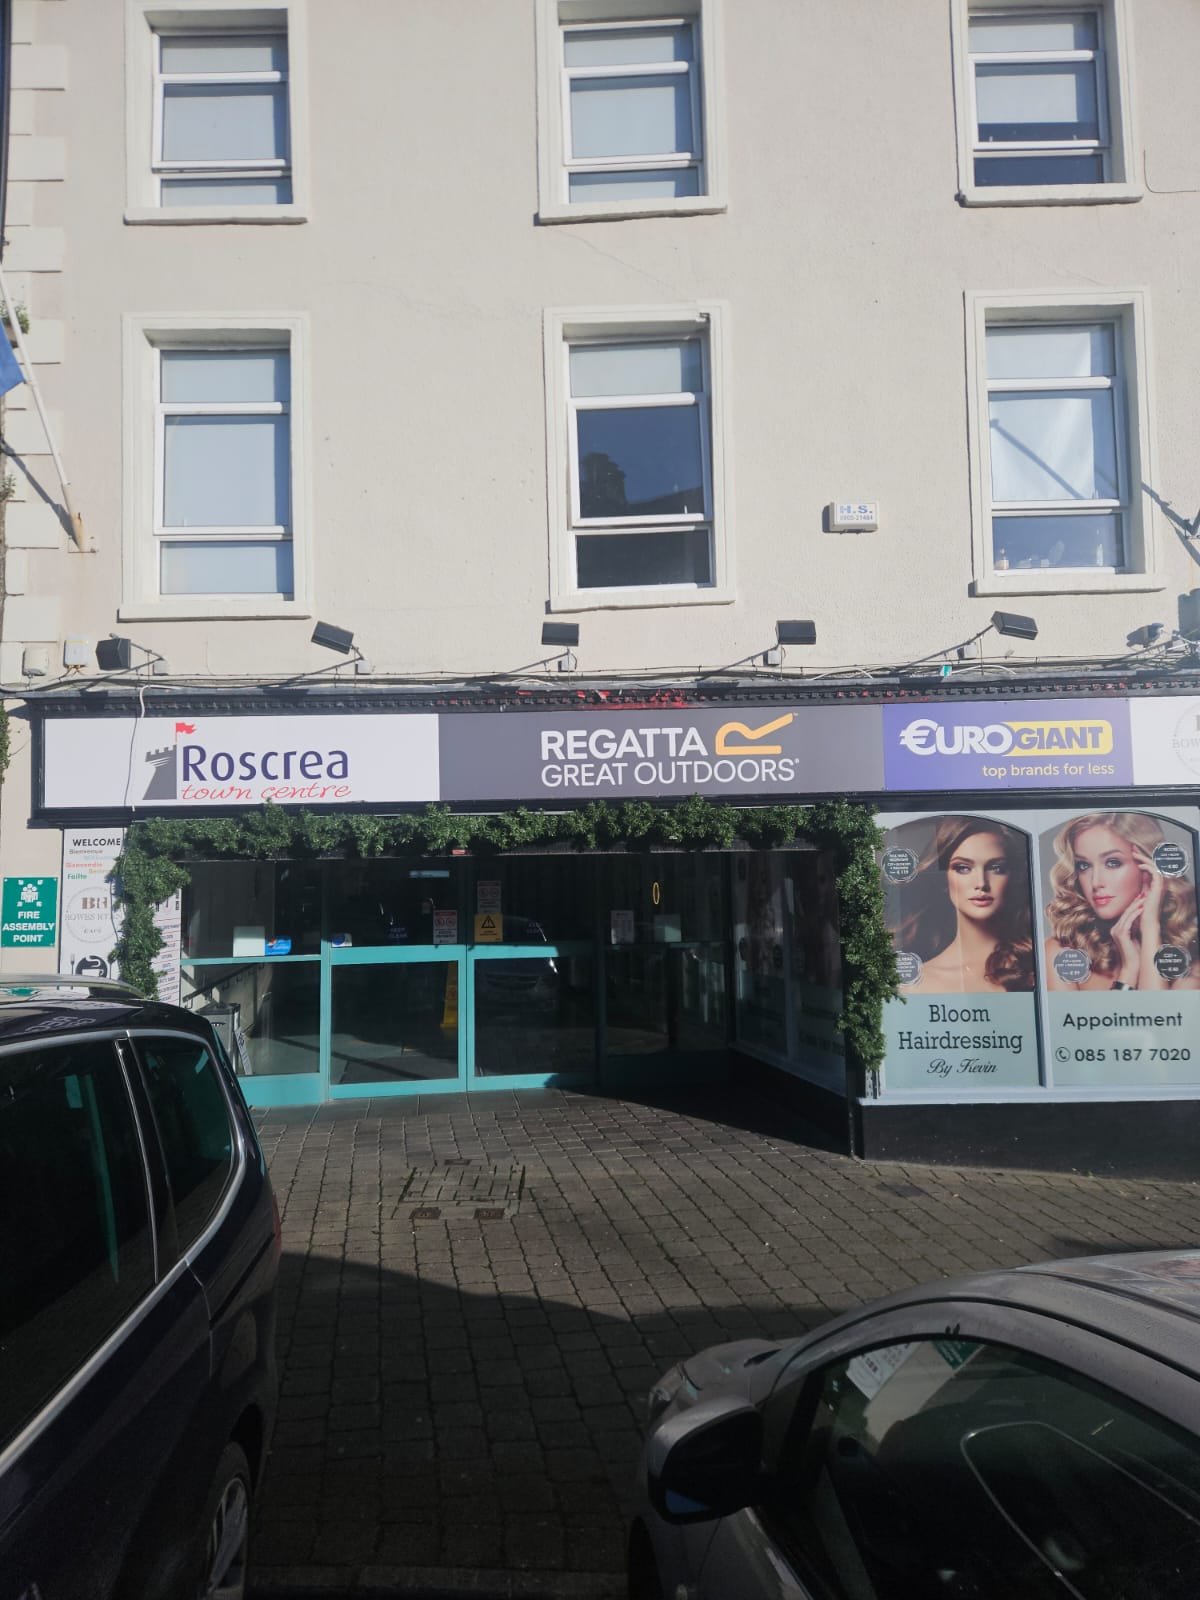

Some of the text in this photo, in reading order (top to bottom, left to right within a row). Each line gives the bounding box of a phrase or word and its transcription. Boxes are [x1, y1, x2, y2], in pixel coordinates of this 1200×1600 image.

[541, 726, 709, 761] REGATTA
[182, 744, 349, 782] Roscrea
[982, 762, 1115, 779] top brands for less
[541, 758, 795, 788] GREAT OUTDOORS
[181, 782, 352, 800] town centre
[72, 838, 121, 847] WELCOME
[17, 911, 41, 919] FIRE
[2, 922, 55, 931] ASSEMBLY
[12, 934, 44, 942] POINT
[928, 1004, 991, 1023] Bloom
[1062, 1012, 1183, 1030] Appointment
[898, 1031, 1023, 1054] Hairdressing
[1074, 1047, 1191, 1062] 085 187 7020
[926, 1058, 952, 1077] By
